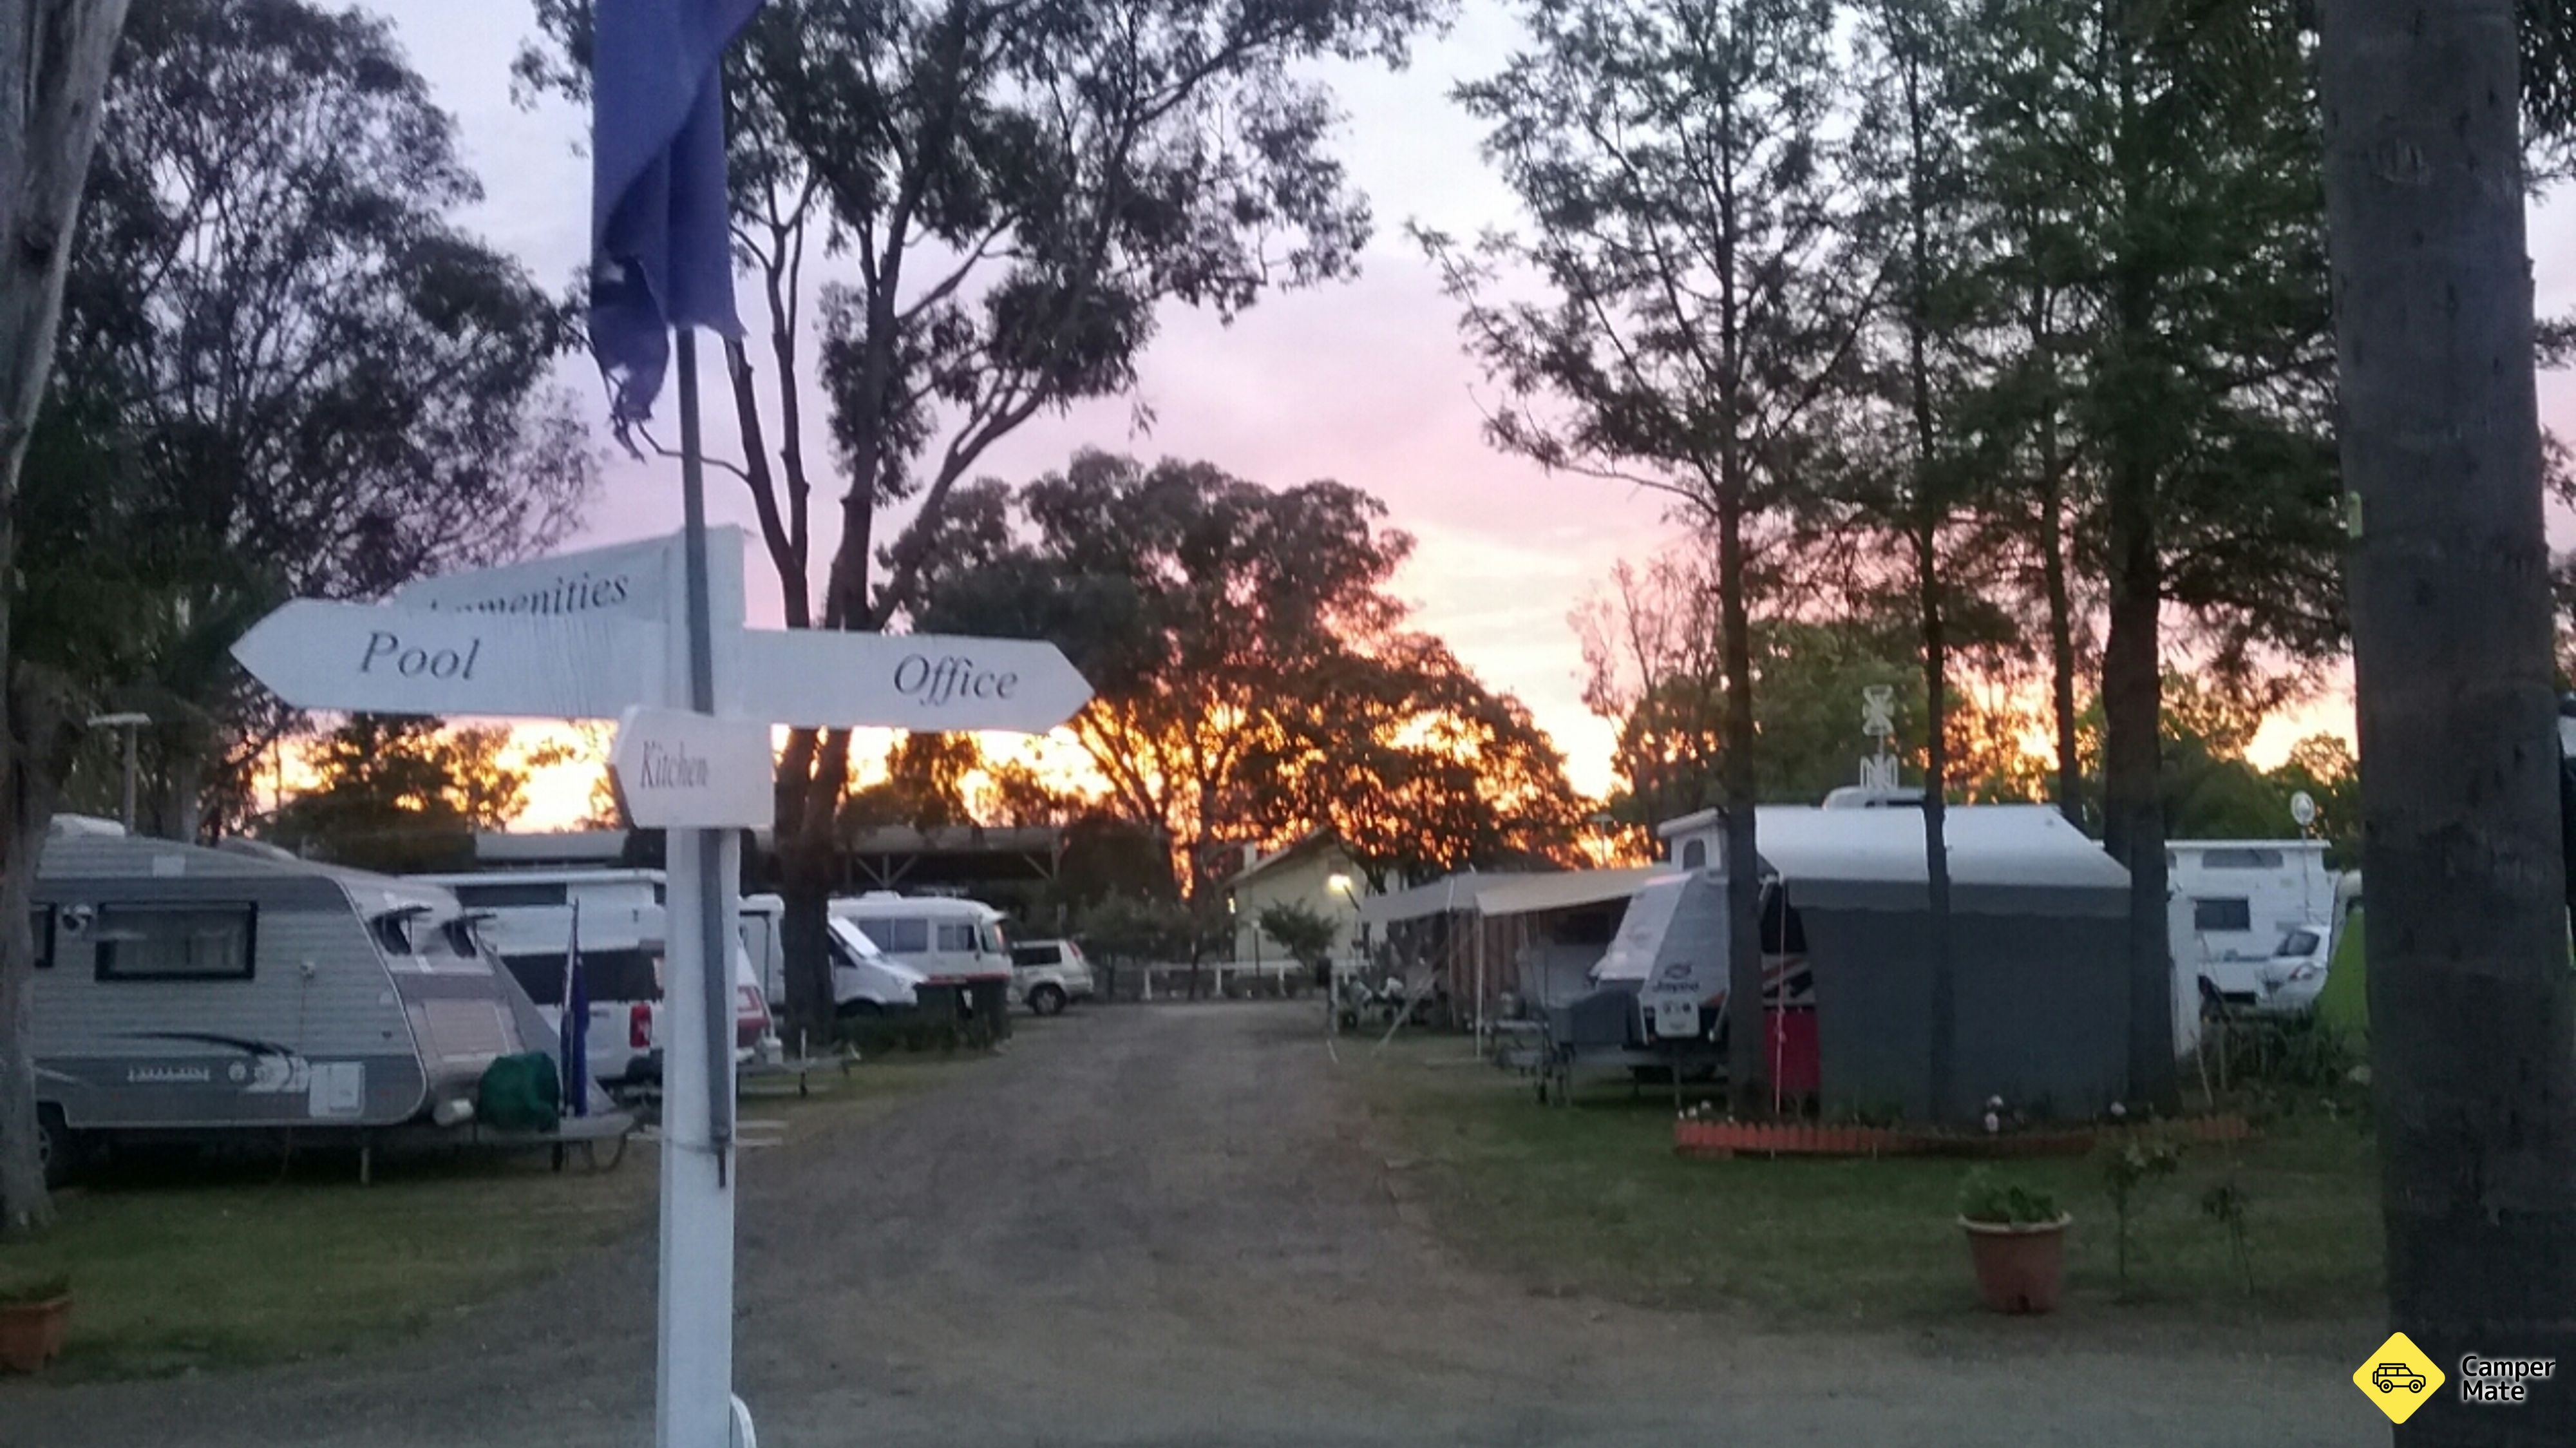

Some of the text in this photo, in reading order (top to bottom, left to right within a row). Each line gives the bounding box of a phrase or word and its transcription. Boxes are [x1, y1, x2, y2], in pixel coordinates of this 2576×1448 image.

[360, 631, 480, 680] Pool
[894, 653, 1018, 707] Office
[640, 740, 708, 788] Kitchen
